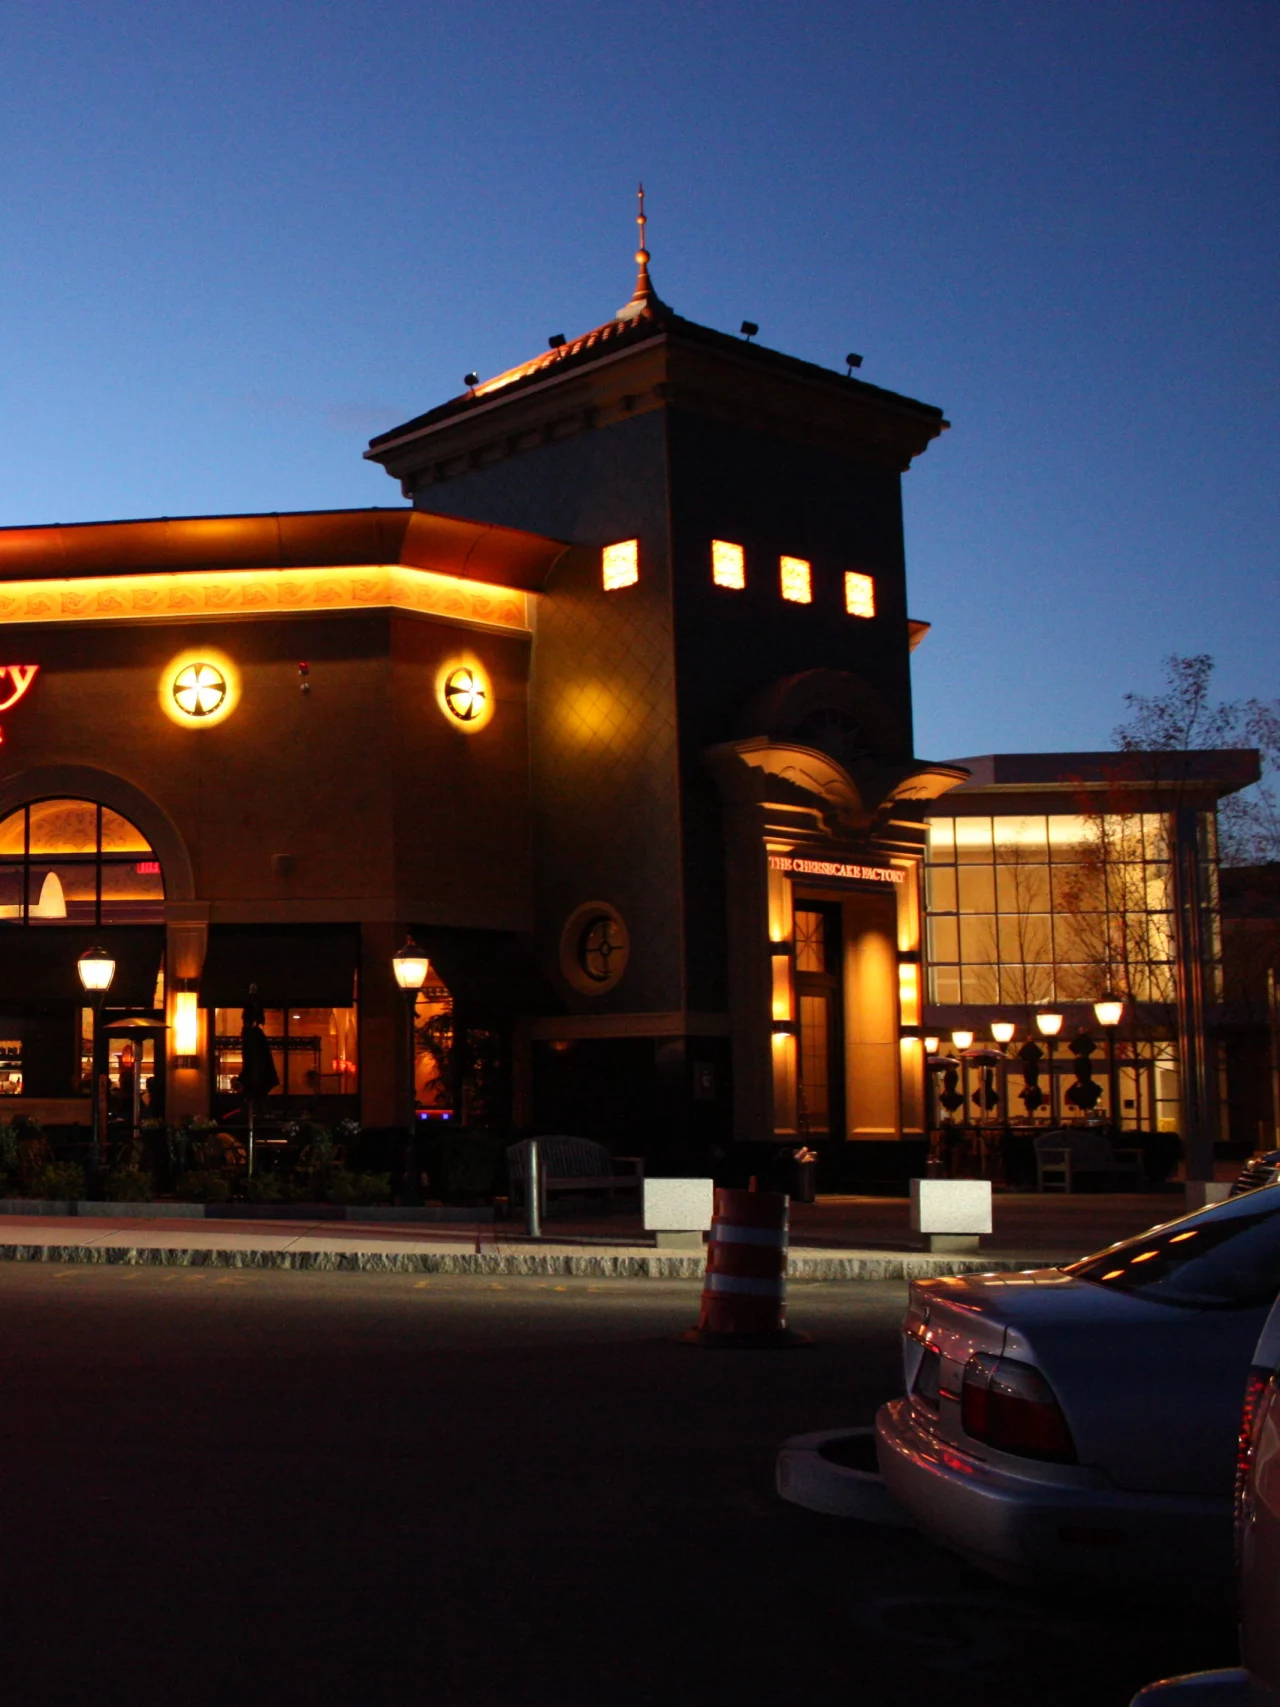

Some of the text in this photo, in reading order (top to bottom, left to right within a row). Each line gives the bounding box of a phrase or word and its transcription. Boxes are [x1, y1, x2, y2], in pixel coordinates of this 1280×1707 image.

[768, 856, 907, 883] THE CHEESECAKE FACTORY
